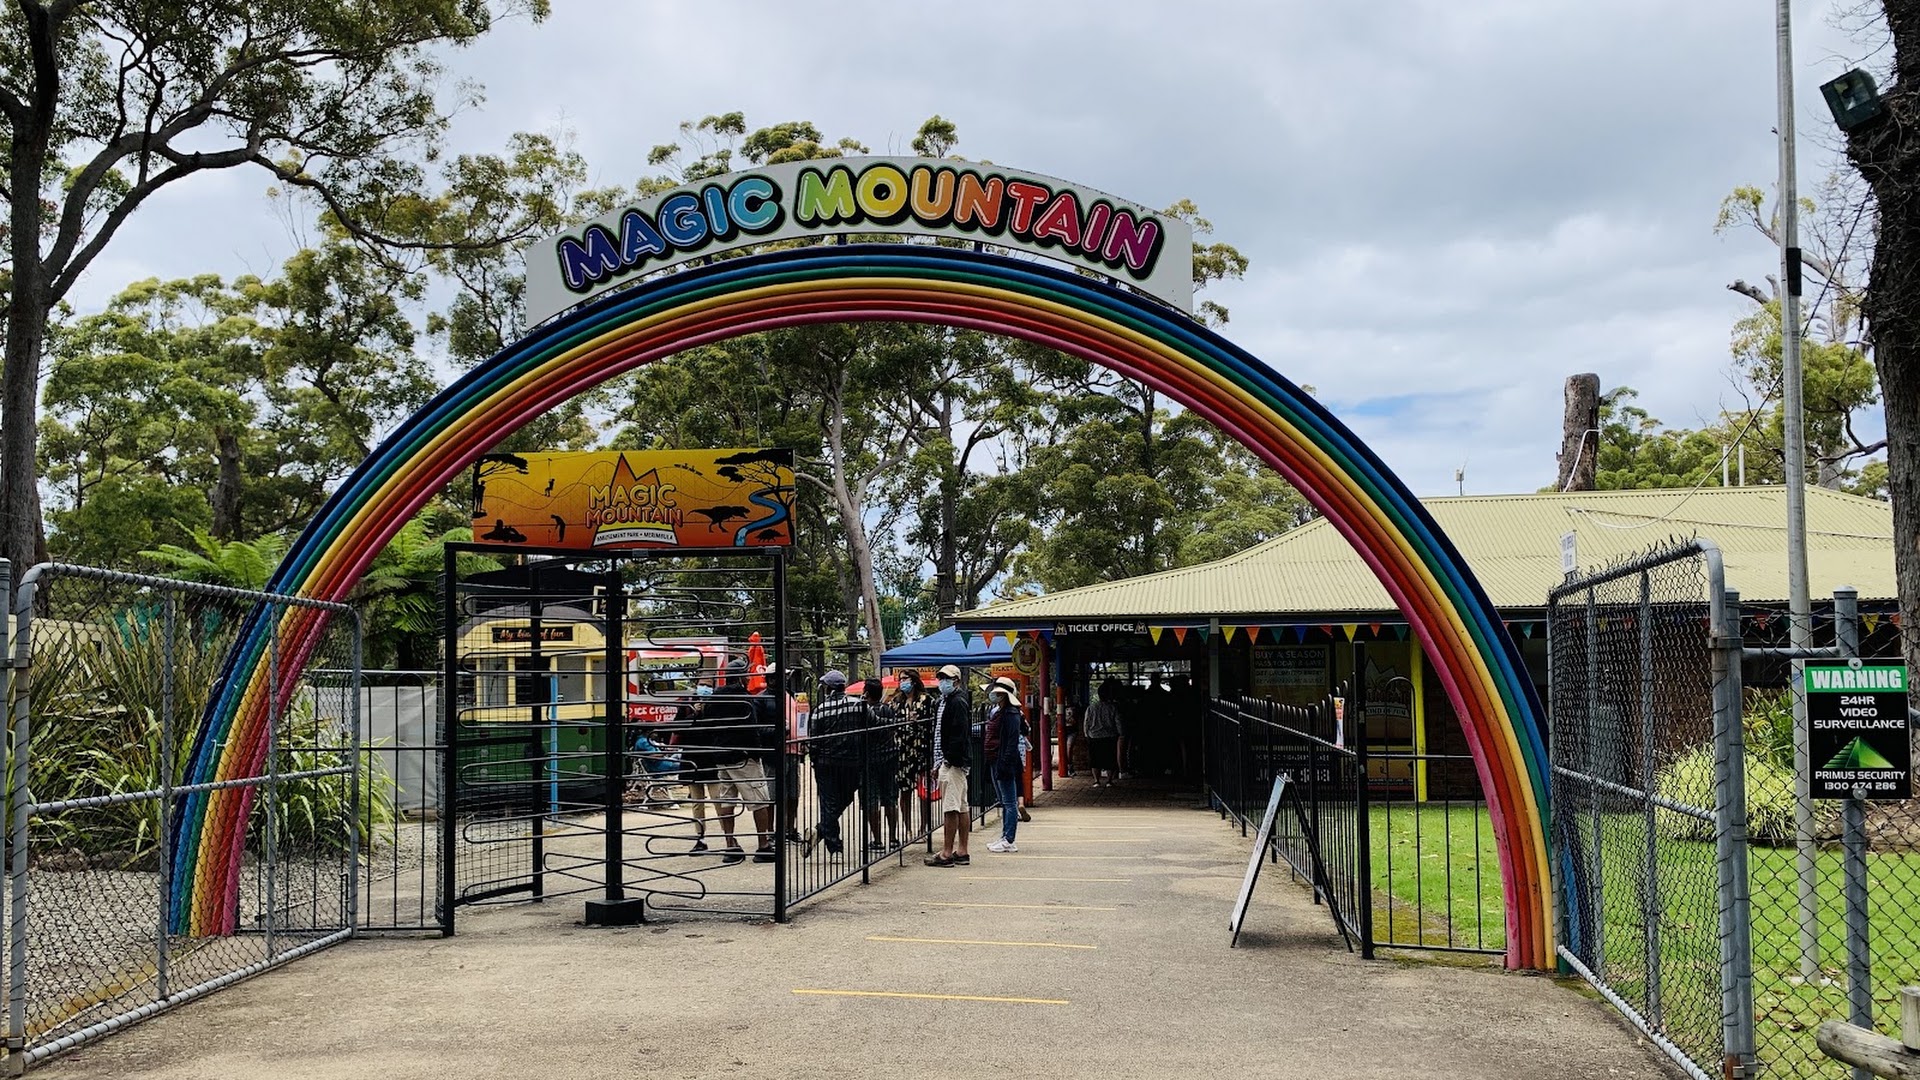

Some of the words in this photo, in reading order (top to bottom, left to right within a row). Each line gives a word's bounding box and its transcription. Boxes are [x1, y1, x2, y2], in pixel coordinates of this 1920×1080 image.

[558, 174, 784, 291] MAGIC
[796, 165, 1164, 279] MOUNTAIN
[589, 484, 676, 509] MAGIC
[585, 506, 683, 528] MOUNTAIN
[1068, 624, 1099, 632] TICKET
[1101, 623, 1134, 632] OFFICE
[1255, 650, 1274, 659] BUY
[1285, 650, 1325, 659] SEASON
[1811, 669, 1902, 689] WARNING
[1840, 696, 1875, 705] 24HR
[1840, 708, 1878, 717] VIDEO
[1814, 720, 1905, 729] SURVEILLANCE
[1815, 771, 1855, 780] PRIMUS
[1857, 771, 1906, 780] SECURITY
[1824, 782, 1849, 790] 1300
[1851, 782, 1873, 790] 474
[1875, 782, 1897, 790] 286
